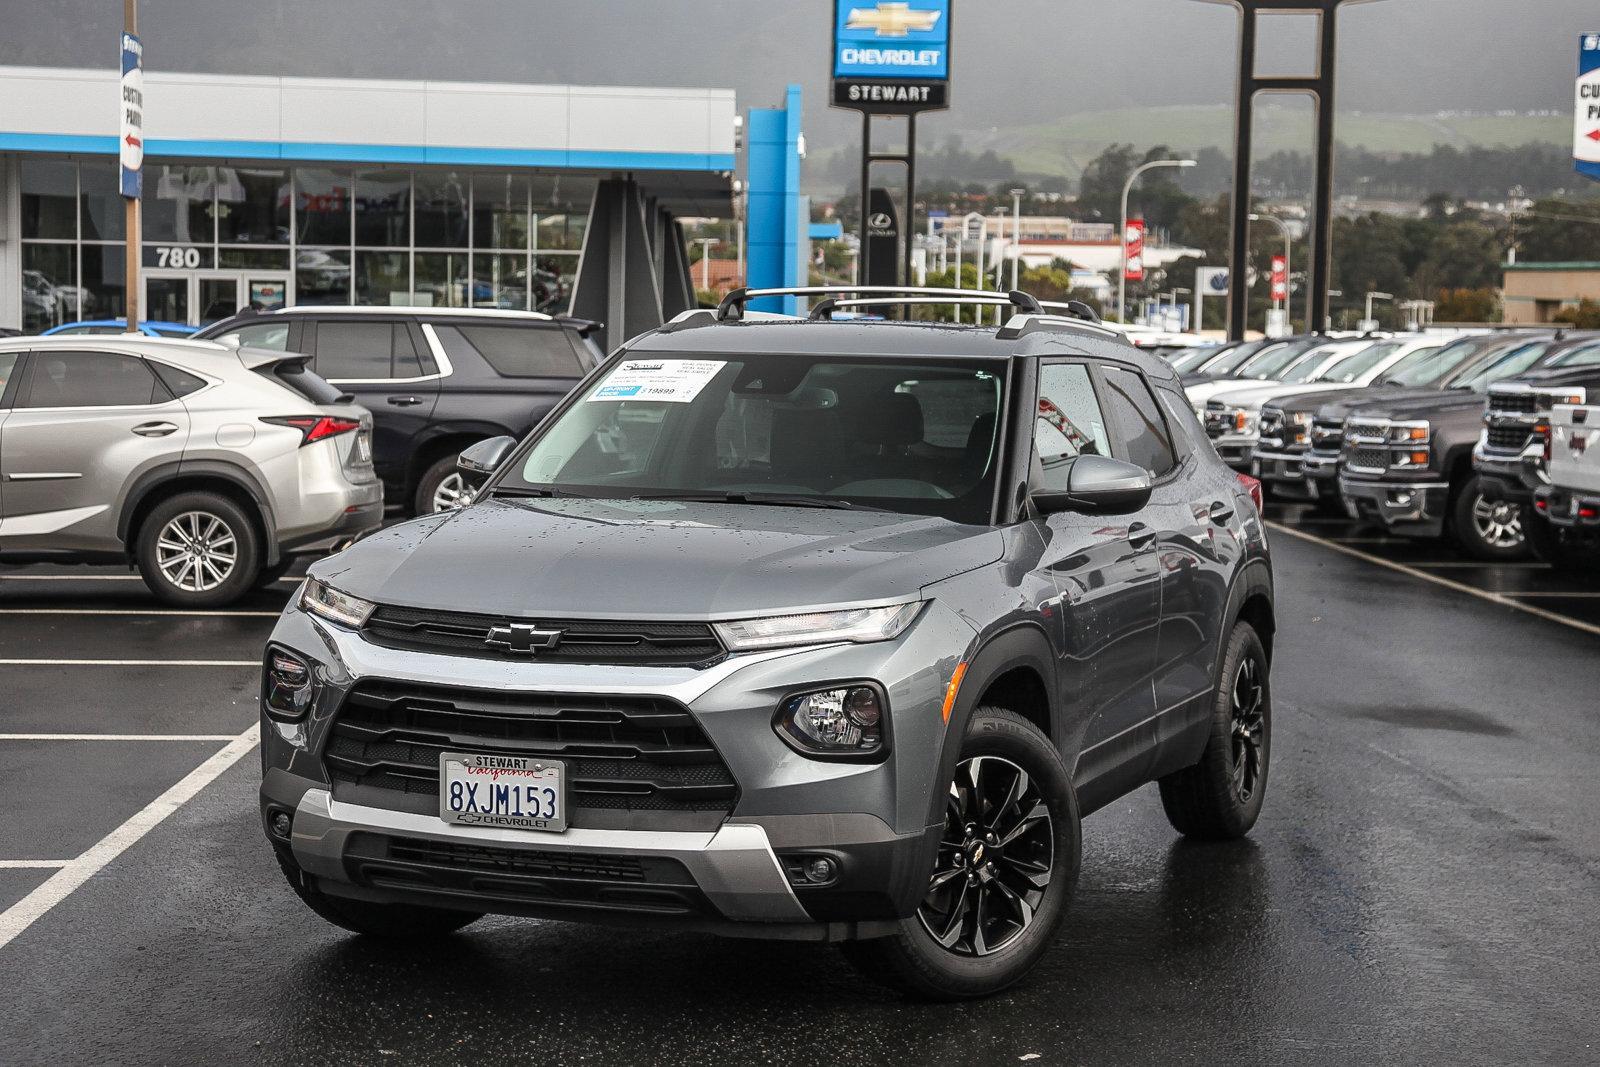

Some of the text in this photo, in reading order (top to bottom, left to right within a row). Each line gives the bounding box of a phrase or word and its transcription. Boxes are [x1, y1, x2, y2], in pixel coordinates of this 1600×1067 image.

[841, 48, 941, 66] CHEVROLET
[848, 84, 931, 101] STEWART
[156, 247, 200, 269] 780
[476, 756, 528, 769] STEWART
[450, 780, 556, 819] 8XJM153
[483, 816, 549, 828] CHEVROLET
